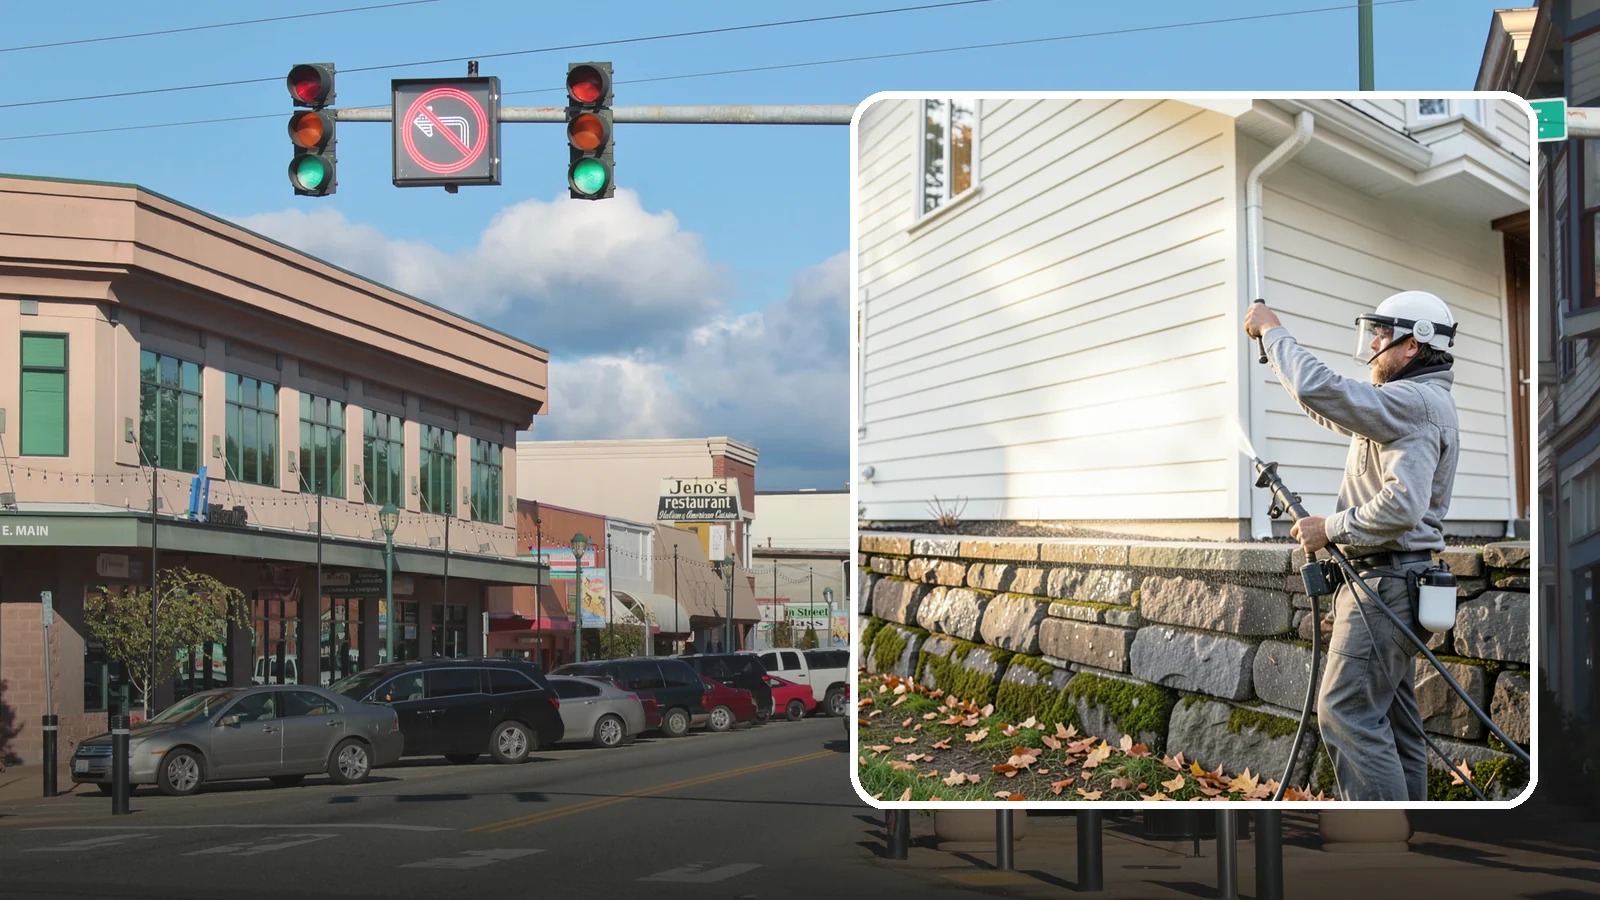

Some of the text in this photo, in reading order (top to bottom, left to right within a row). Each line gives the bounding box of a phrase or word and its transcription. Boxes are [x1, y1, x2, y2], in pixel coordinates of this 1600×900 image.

[669, 480, 728, 495] Jeno's
[665, 496, 731, 509] restaurant
[658, 509, 682, 520] Italian
[685, 509, 715, 520] American
[714, 509, 738, 519] Cuisine
[2, 525, 49, 536] E. MAIN
[797, 607, 829, 617] Street
